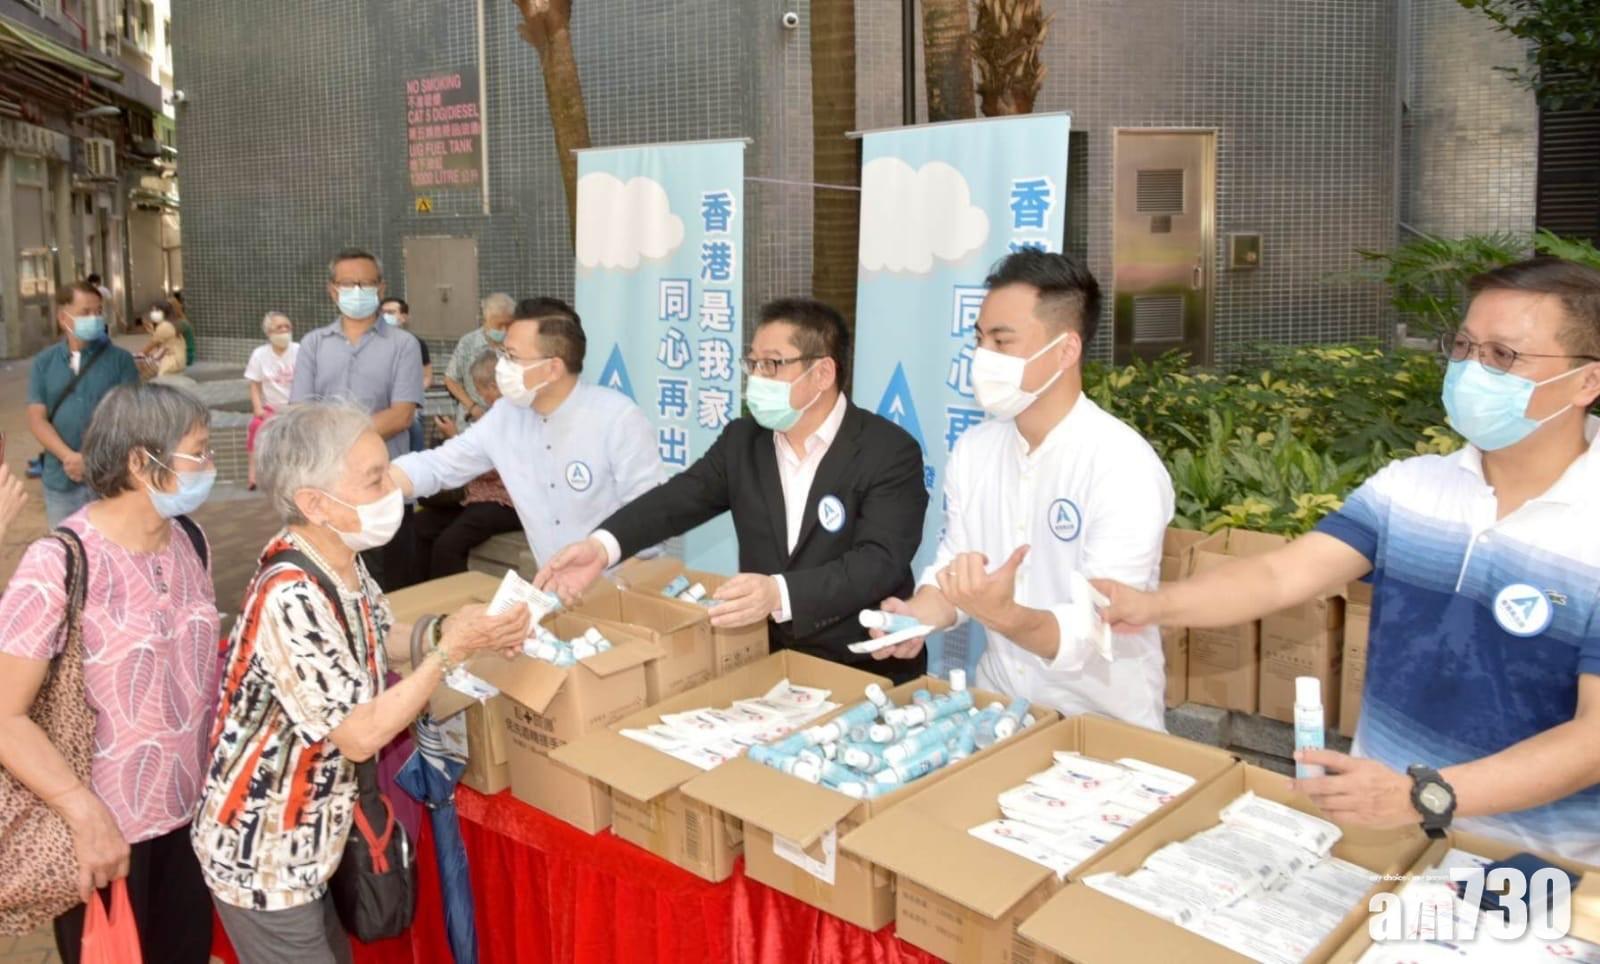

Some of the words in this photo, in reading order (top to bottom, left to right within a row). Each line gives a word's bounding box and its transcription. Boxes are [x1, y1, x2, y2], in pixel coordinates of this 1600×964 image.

[407, 80, 420, 94] NO
[421, 74, 461, 93] SMOKING
[408, 109, 424, 124] CAT
[425, 141, 448, 156] FUEL
[449, 139, 473, 154] TANK
[1008, 178, 1051, 255] 香
[699, 190, 734, 430] 香港是我家
[656, 278, 692, 466] 同心再出
